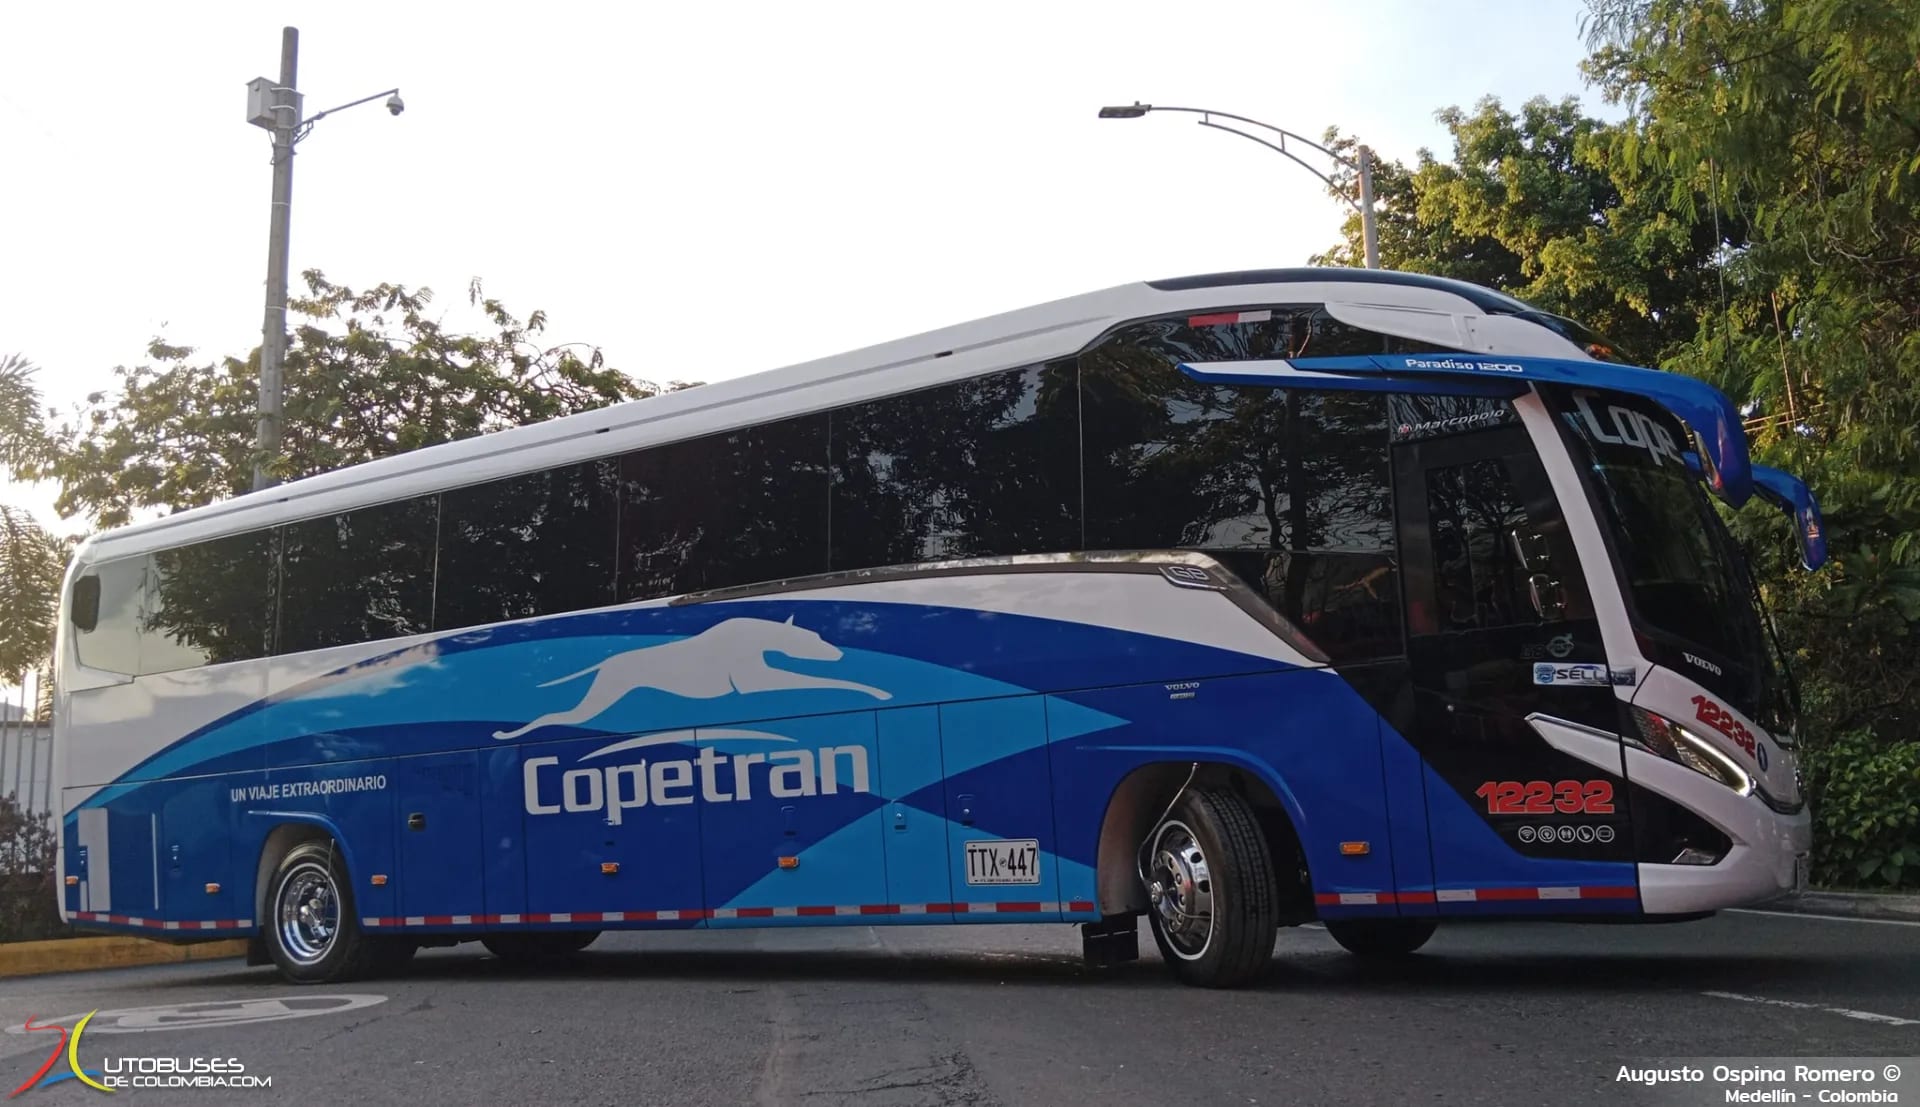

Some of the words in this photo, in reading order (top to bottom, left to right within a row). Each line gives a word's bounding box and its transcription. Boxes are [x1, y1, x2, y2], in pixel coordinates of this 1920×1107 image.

[1405, 358, 1474, 370] Paradiso
[1476, 362, 1524, 373] 1200
[1414, 409, 1505, 431] Marcopolo
[1682, 652, 1722, 676] VOLVO
[1164, 682, 1200, 690] VOLVO
[1690, 694, 1756, 760] 12232
[231, 788, 246, 802] UN
[249, 785, 279, 800] VIAJE
[282, 775, 387, 798] EXTRAORDINARIO
[523, 744, 870, 826] Copetran
[1476, 780, 1615, 814] 12232
